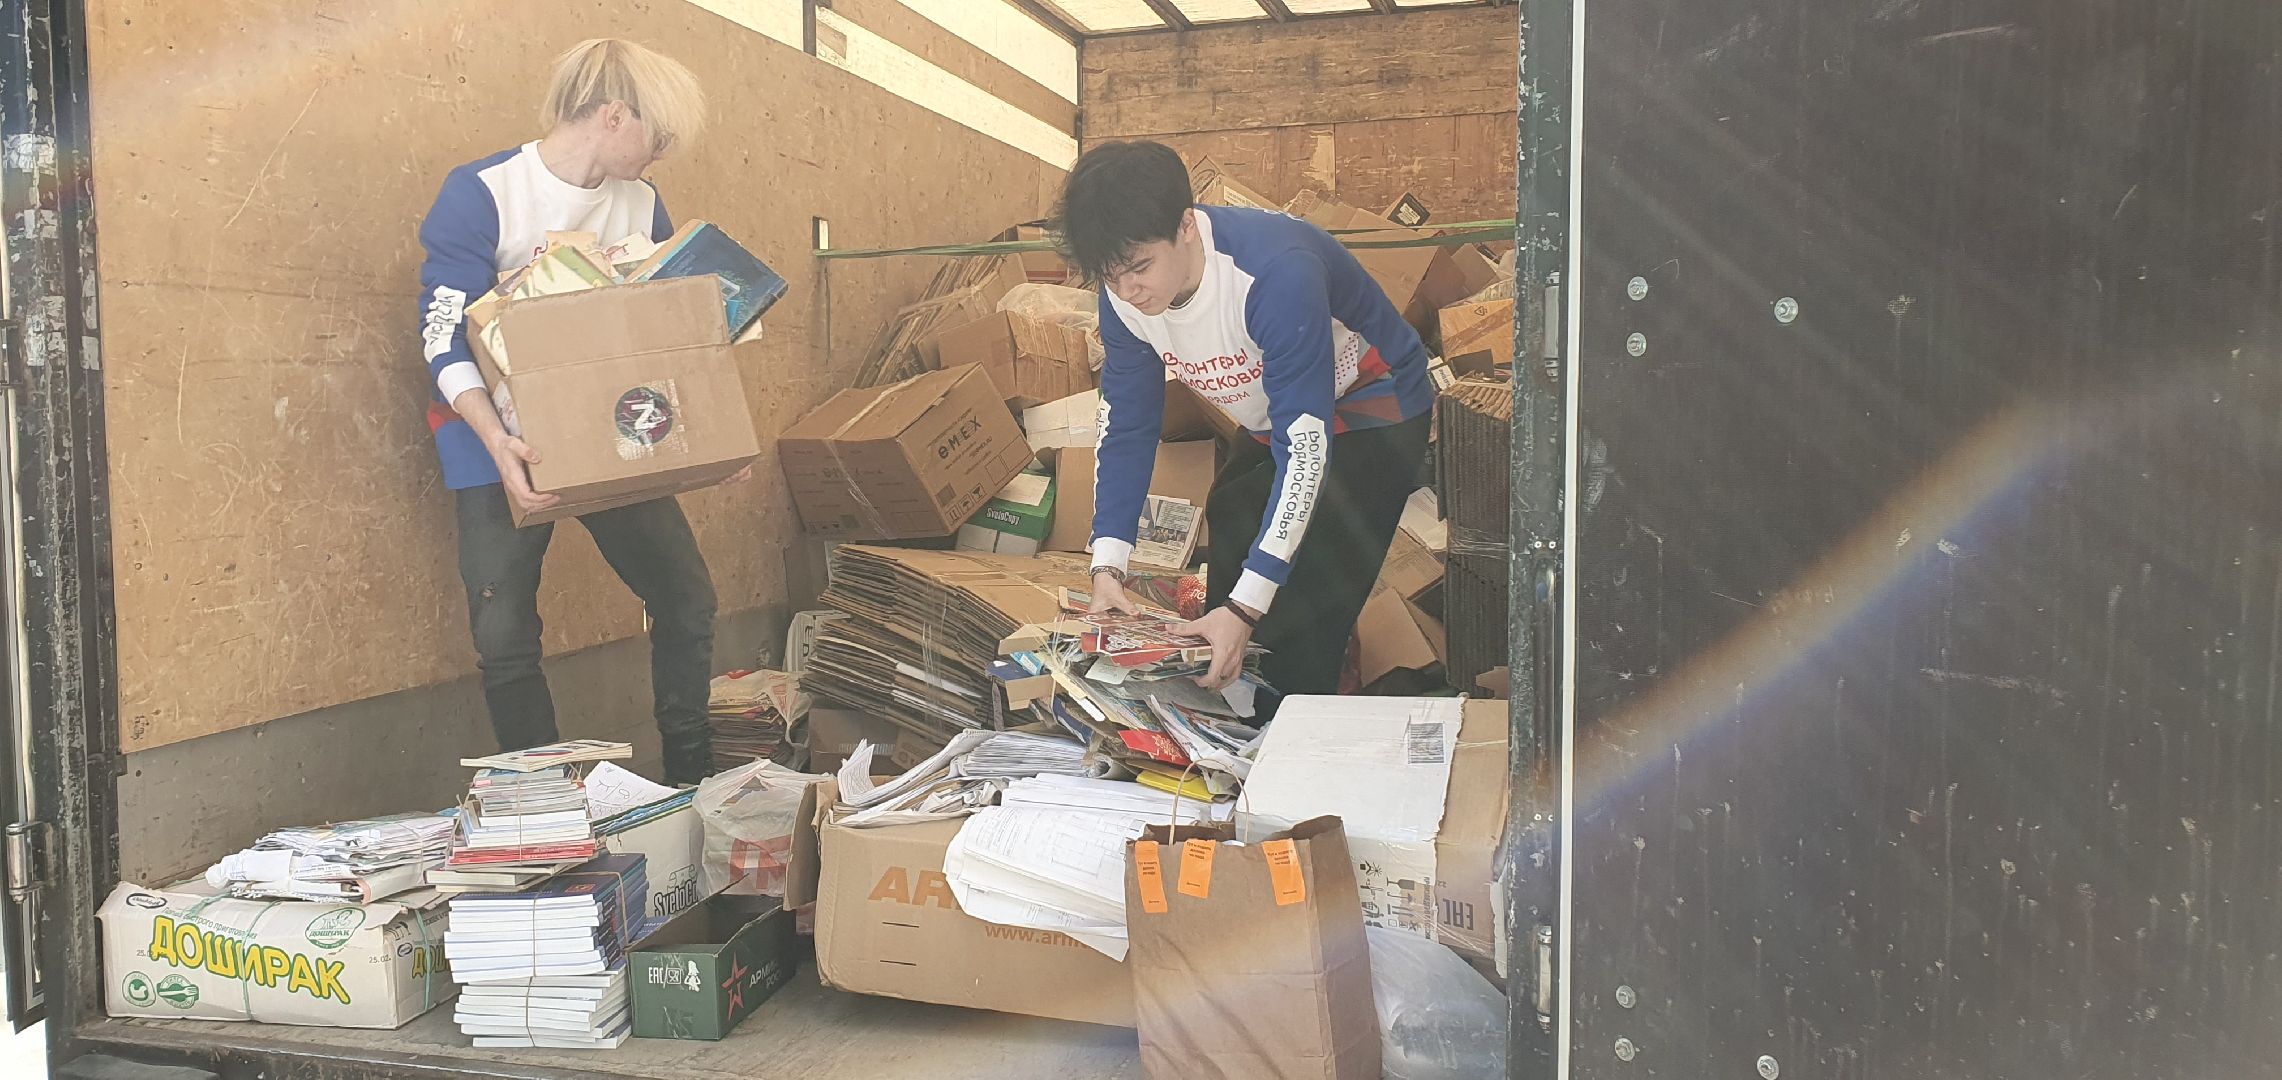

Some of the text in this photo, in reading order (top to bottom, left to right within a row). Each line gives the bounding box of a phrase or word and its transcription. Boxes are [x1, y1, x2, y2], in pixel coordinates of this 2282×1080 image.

[1275, 432, 1307, 540] ПОДМОСКОВЬЯ
[1297, 431, 1321, 522] ВОЛОНТЕРЫ
[867, 866, 962, 911] AR
[150, 914, 351, 1005] ДОШИРАК
